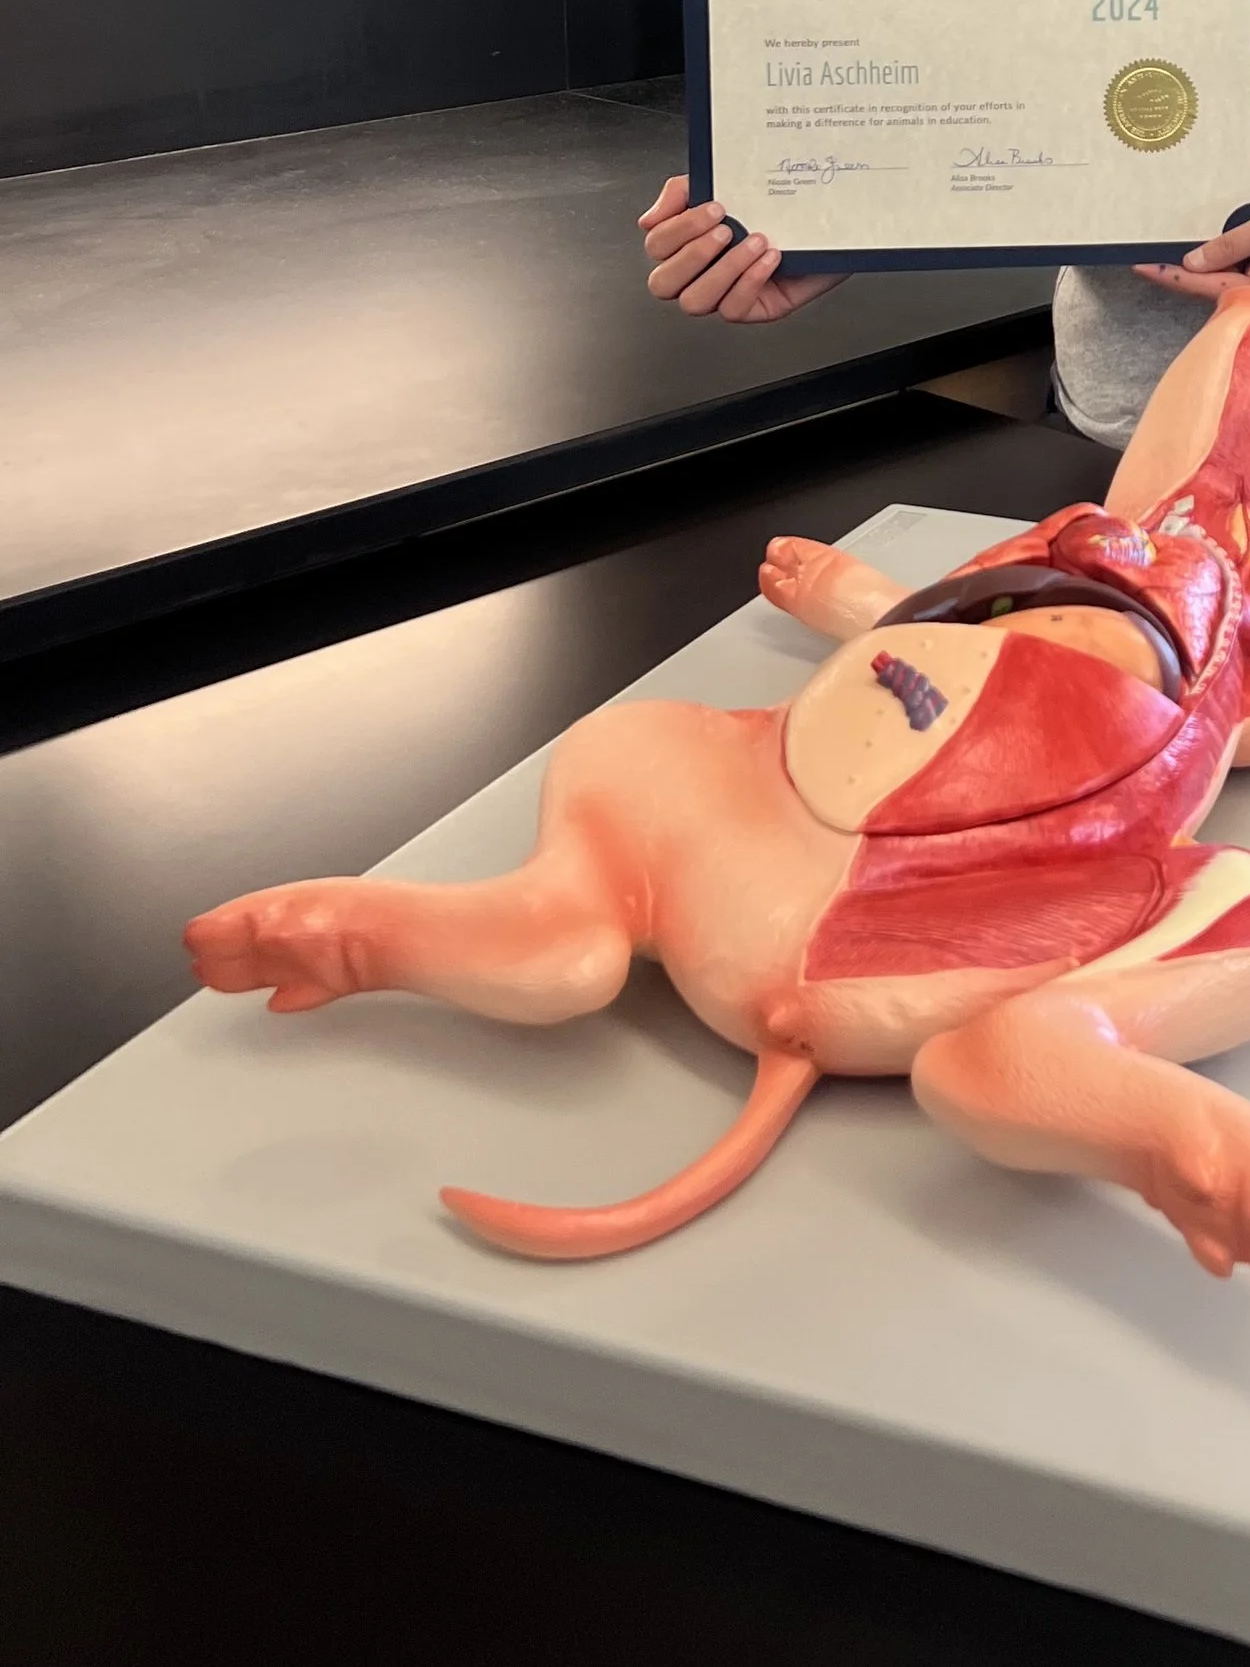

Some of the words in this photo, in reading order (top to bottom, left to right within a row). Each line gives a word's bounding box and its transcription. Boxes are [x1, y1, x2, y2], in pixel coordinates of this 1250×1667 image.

[764, 39, 781, 48] We
[784, 38, 819, 49] hereby
[822, 38, 860, 49] present
[766, 61, 813, 87] Livia
[820, 60, 919, 86] Aschheim
[766, 105, 788, 115] with
[791, 105, 810, 114] this
[813, 104, 865, 114] certificate
[867, 104, 878, 113] in
[880, 103, 938, 114] recognition
[940, 102, 951, 112] of
[953, 104, 976, 114] your
[979, 101, 1013, 111] efforts
[1016, 102, 1025, 110] in
[766, 118, 803, 130] making
[805, 120, 812, 128] a
[814, 117, 867, 128] difference
[868, 117, 884, 127] for
[886, 116, 924, 127] animals
[927, 116, 937, 125] in
[939, 115, 992, 126] education.
